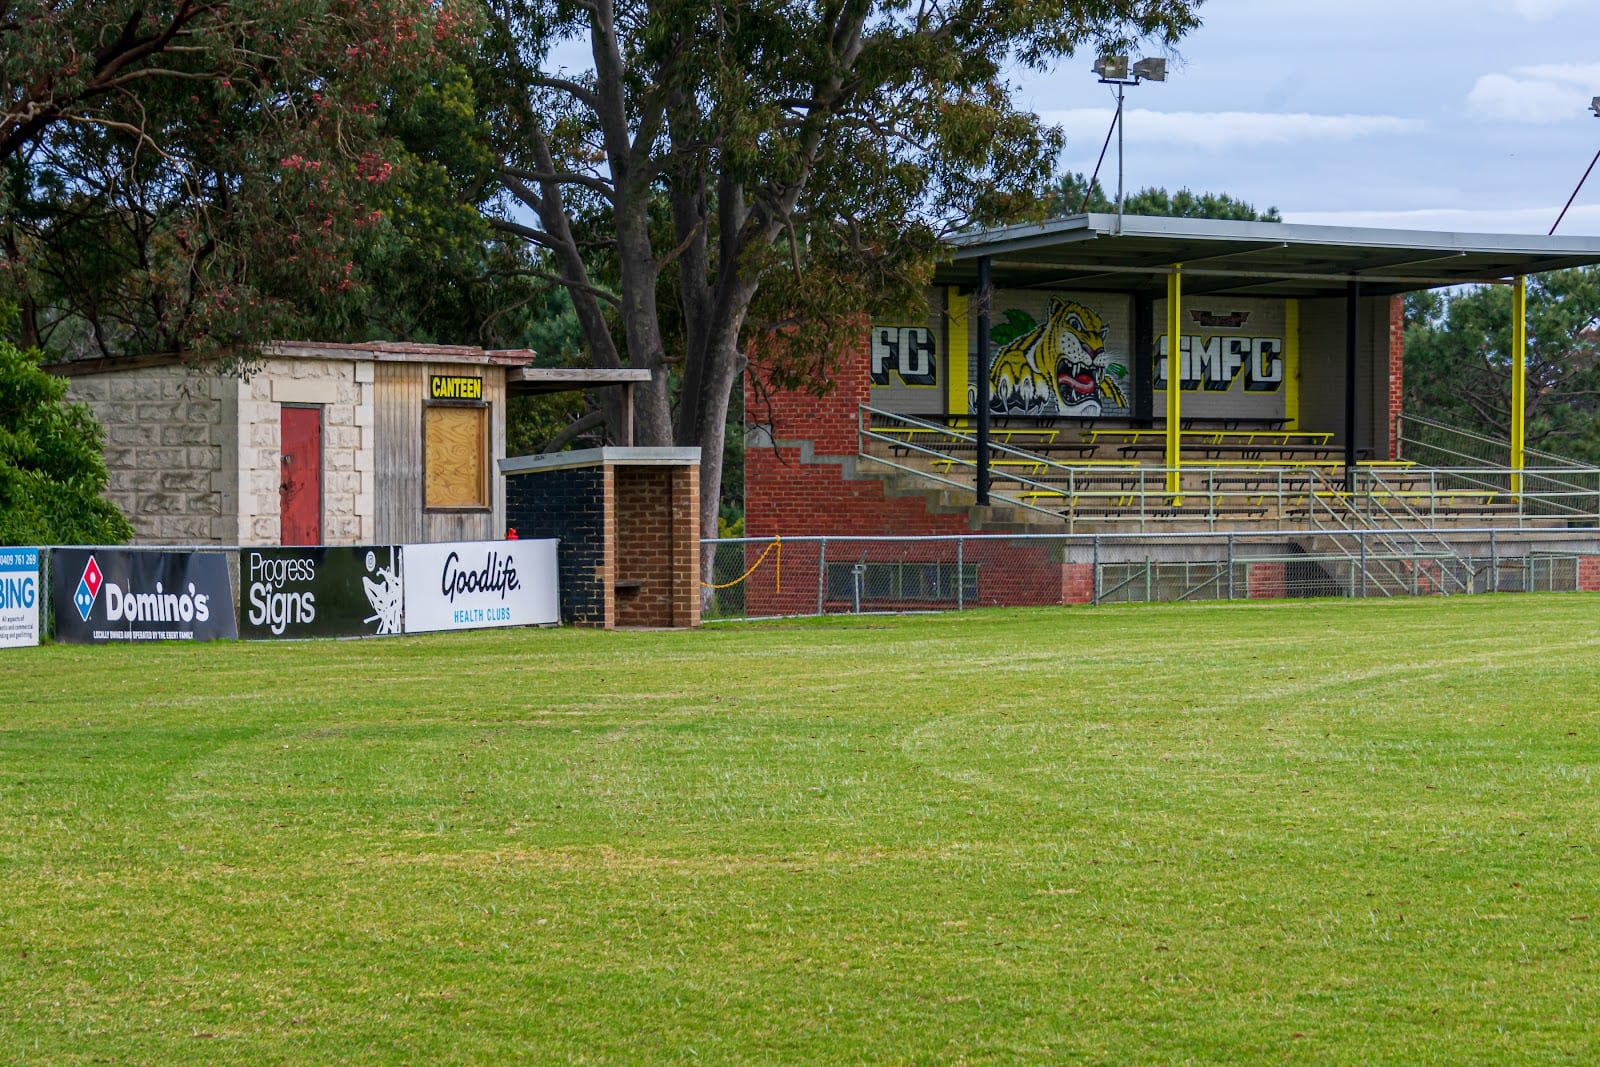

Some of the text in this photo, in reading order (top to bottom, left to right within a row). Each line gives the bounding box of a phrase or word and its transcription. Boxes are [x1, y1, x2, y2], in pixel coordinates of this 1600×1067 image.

[1154, 334, 1282, 390] SMFC
[432, 376, 481, 398] CANTEEN
[0, 554, 13, 566] 0409
[15, 554, 25, 565] 761
[250, 552, 315, 588] Progress
[442, 551, 521, 604] Goodlife.
[105, 581, 210, 622] Domino's
[249, 582, 315, 635] Signs
[454, 607, 511, 623] HEALTH CLUBS
[93, 630, 109, 639] LOCALLY
[110, 630, 124, 639] OWNED
[124, 631, 132, 639] AND
[133, 631, 152, 639] OPERATED
[158, 631, 166, 640] THE
[179, 631, 194, 639] FAMILY
